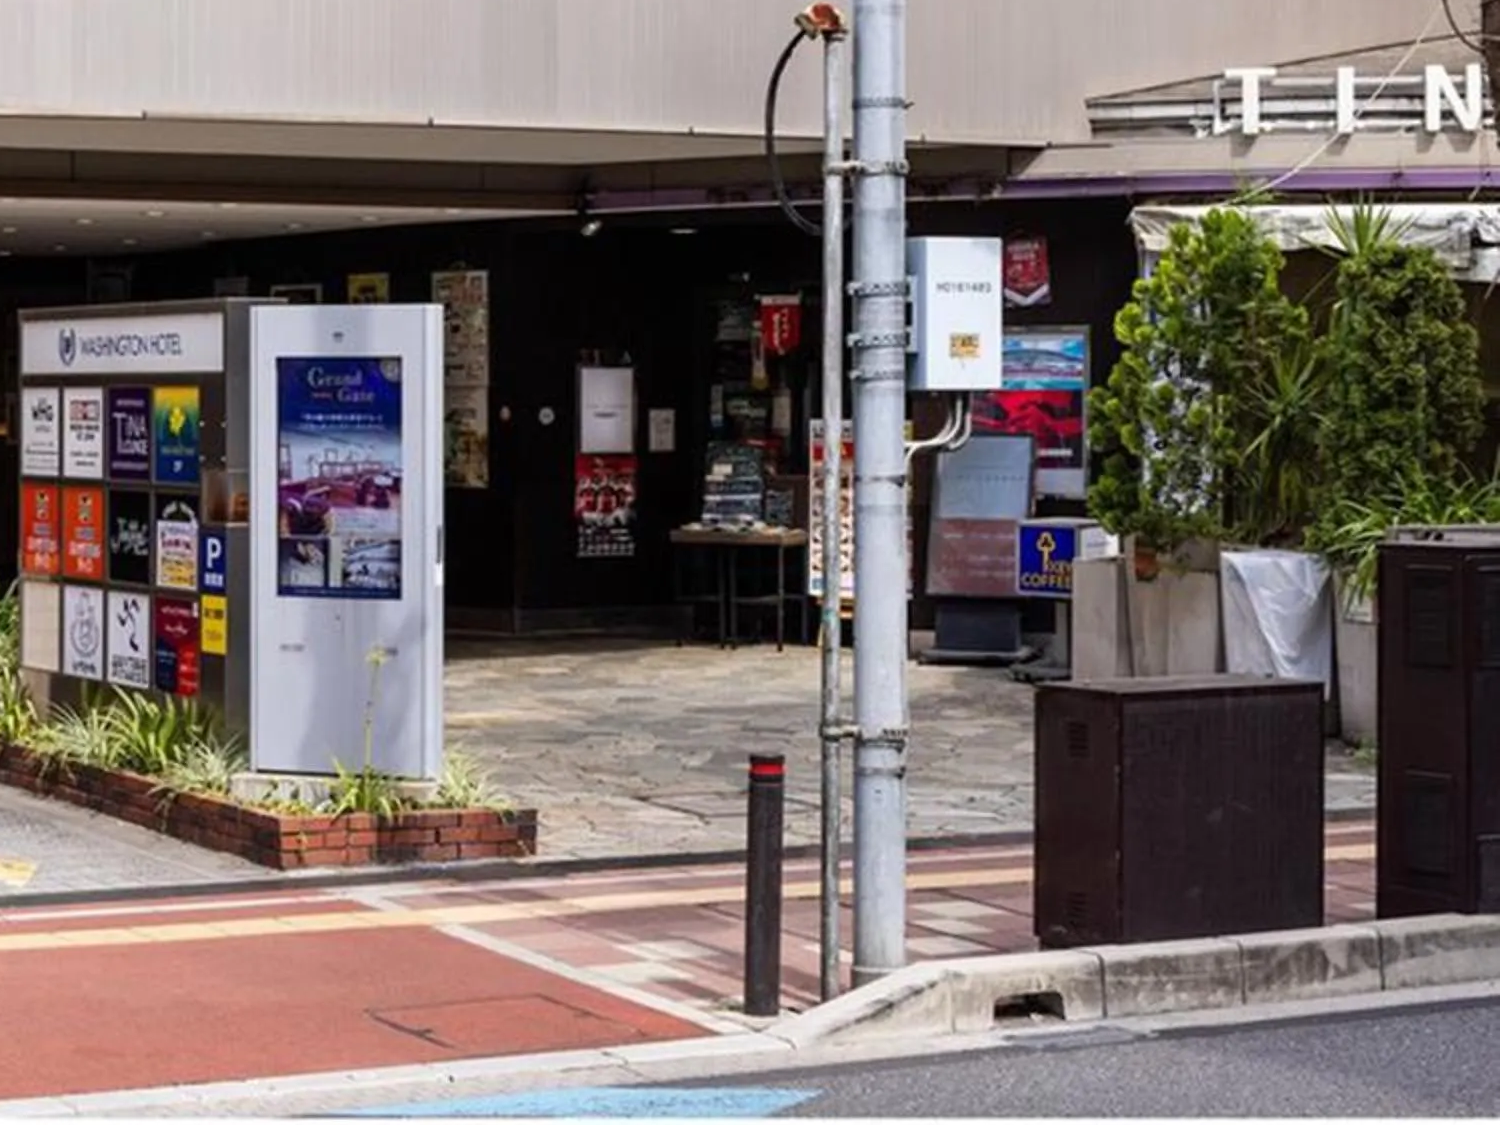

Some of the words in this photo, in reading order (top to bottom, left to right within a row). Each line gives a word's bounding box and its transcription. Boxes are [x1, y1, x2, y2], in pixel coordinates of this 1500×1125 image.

[79, 333, 149, 357] WASHINGTON
[150, 332, 183, 356] HOTEL
[206, 536, 222, 568] P
